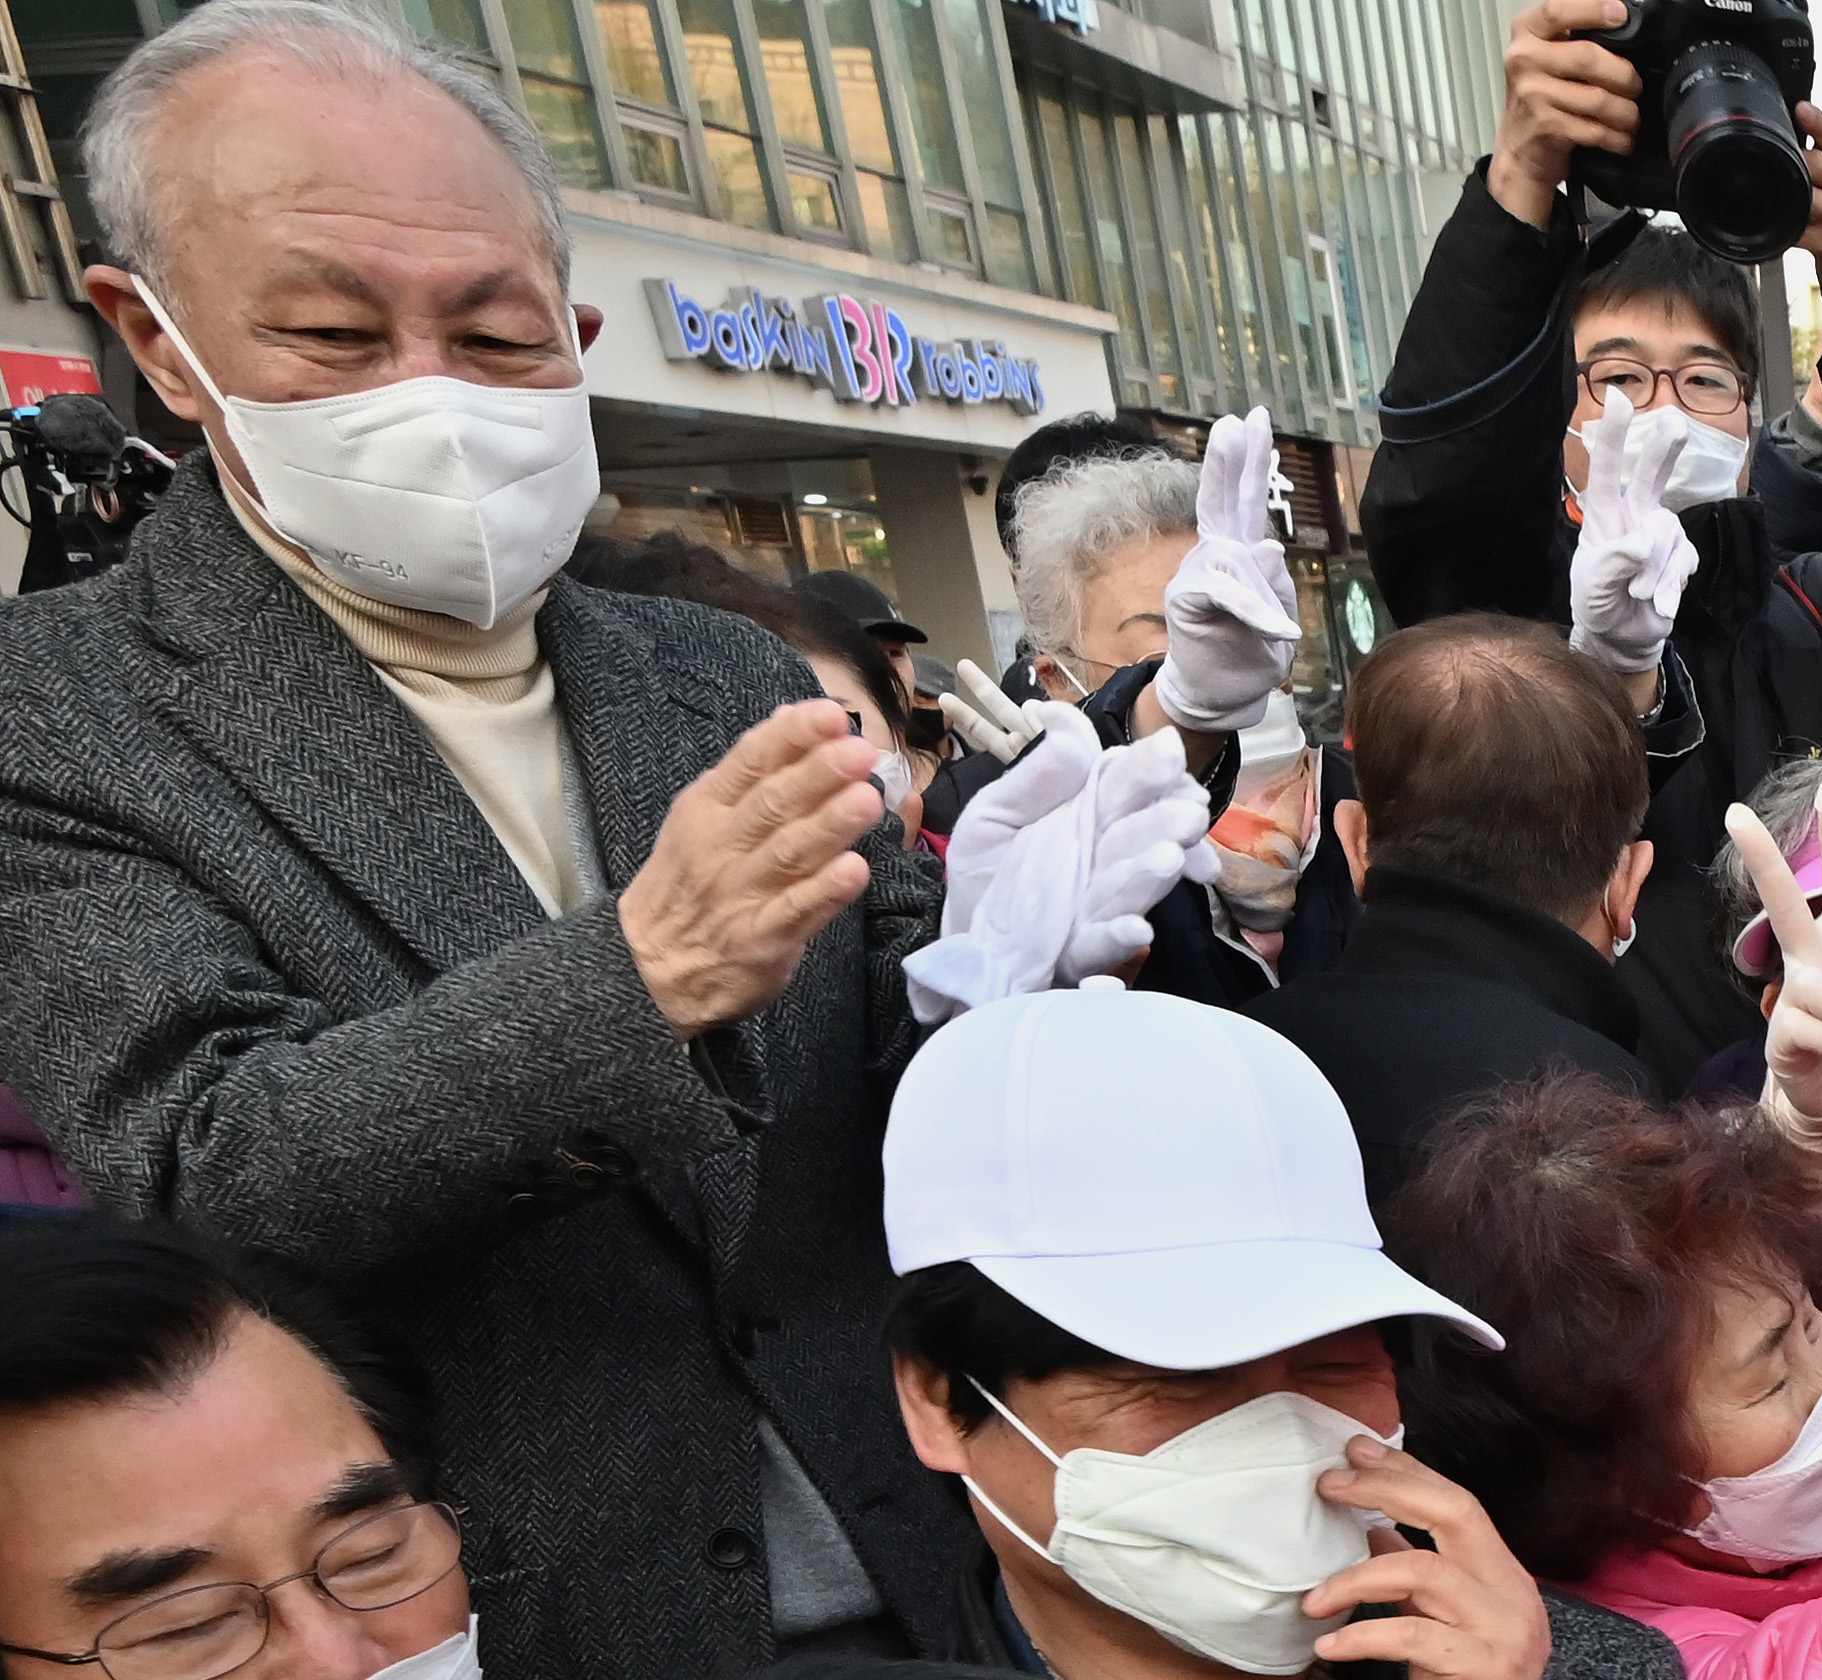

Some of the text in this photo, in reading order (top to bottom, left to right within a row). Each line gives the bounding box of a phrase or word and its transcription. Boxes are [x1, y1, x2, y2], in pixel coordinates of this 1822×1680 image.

[662, 278, 834, 385] baskin
[918, 335, 1047, 415] robbins
[334, 548, 409, 580] KF-94
